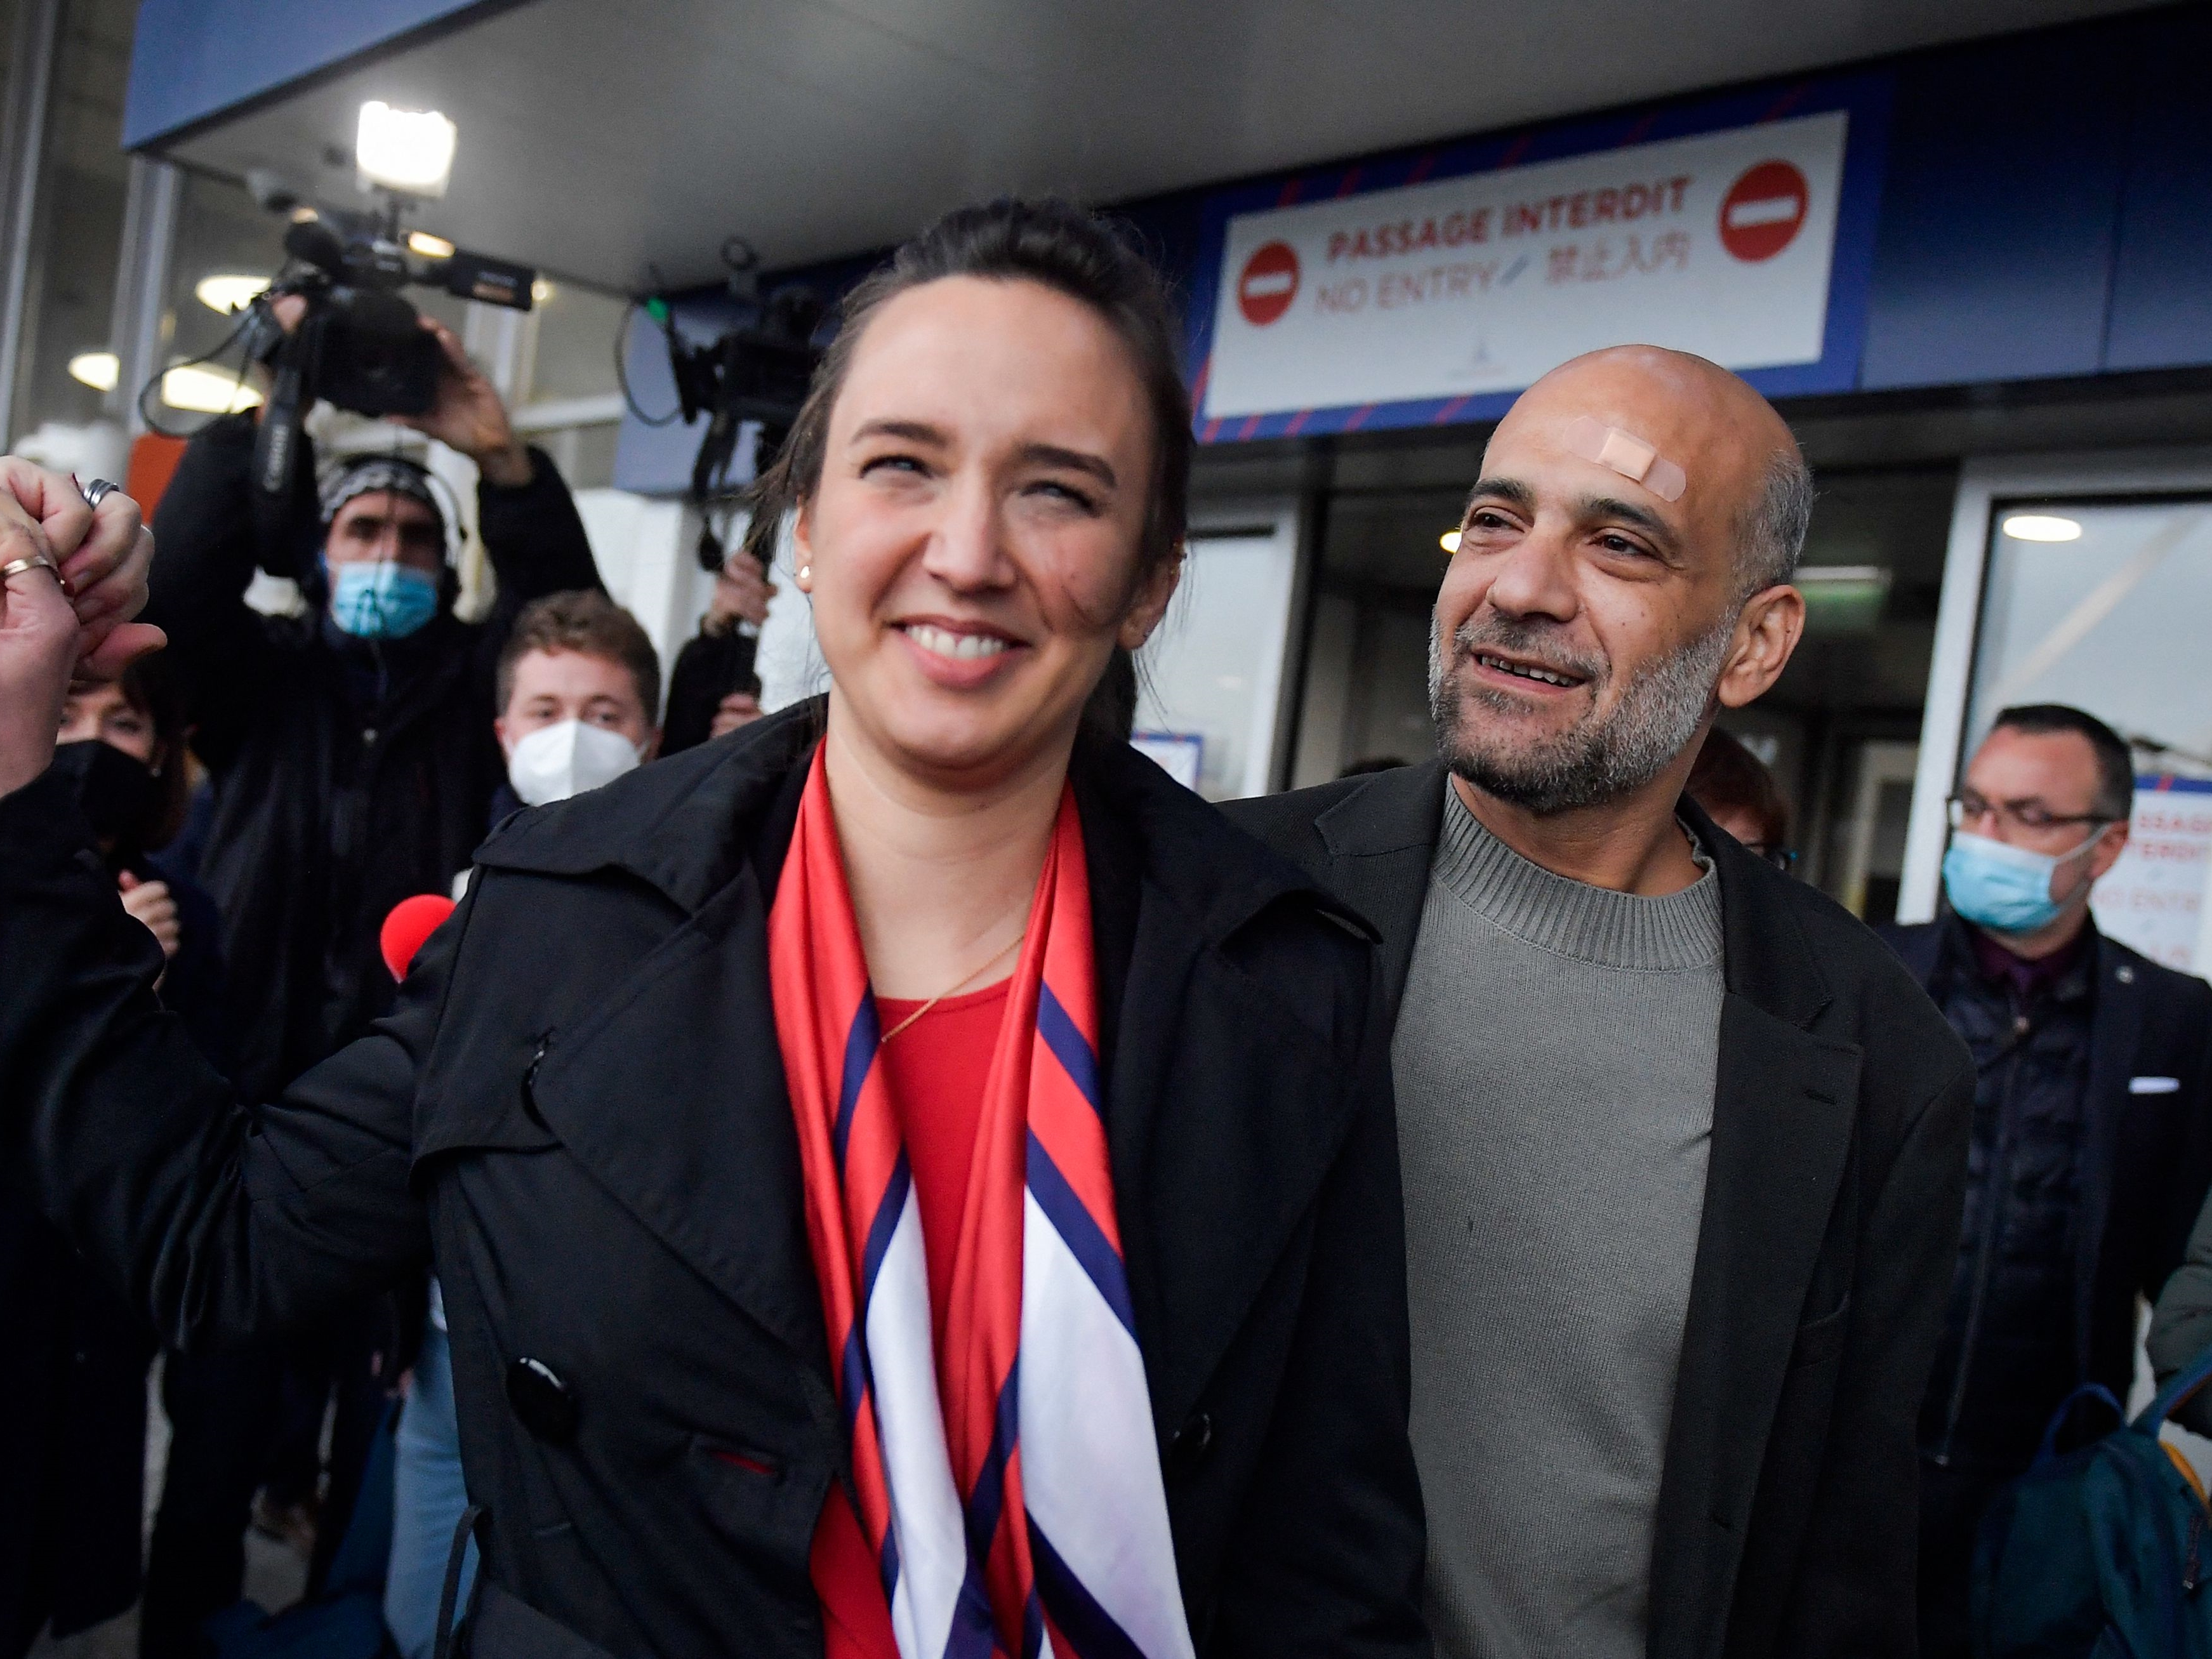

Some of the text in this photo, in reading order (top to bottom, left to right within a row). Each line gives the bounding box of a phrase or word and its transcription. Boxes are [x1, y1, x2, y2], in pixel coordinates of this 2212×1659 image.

[1326, 174, 1693, 264] PASSAGE INTERDIT
[1316, 278, 1368, 314] NO
[1377, 259, 1499, 310] ENTRY
